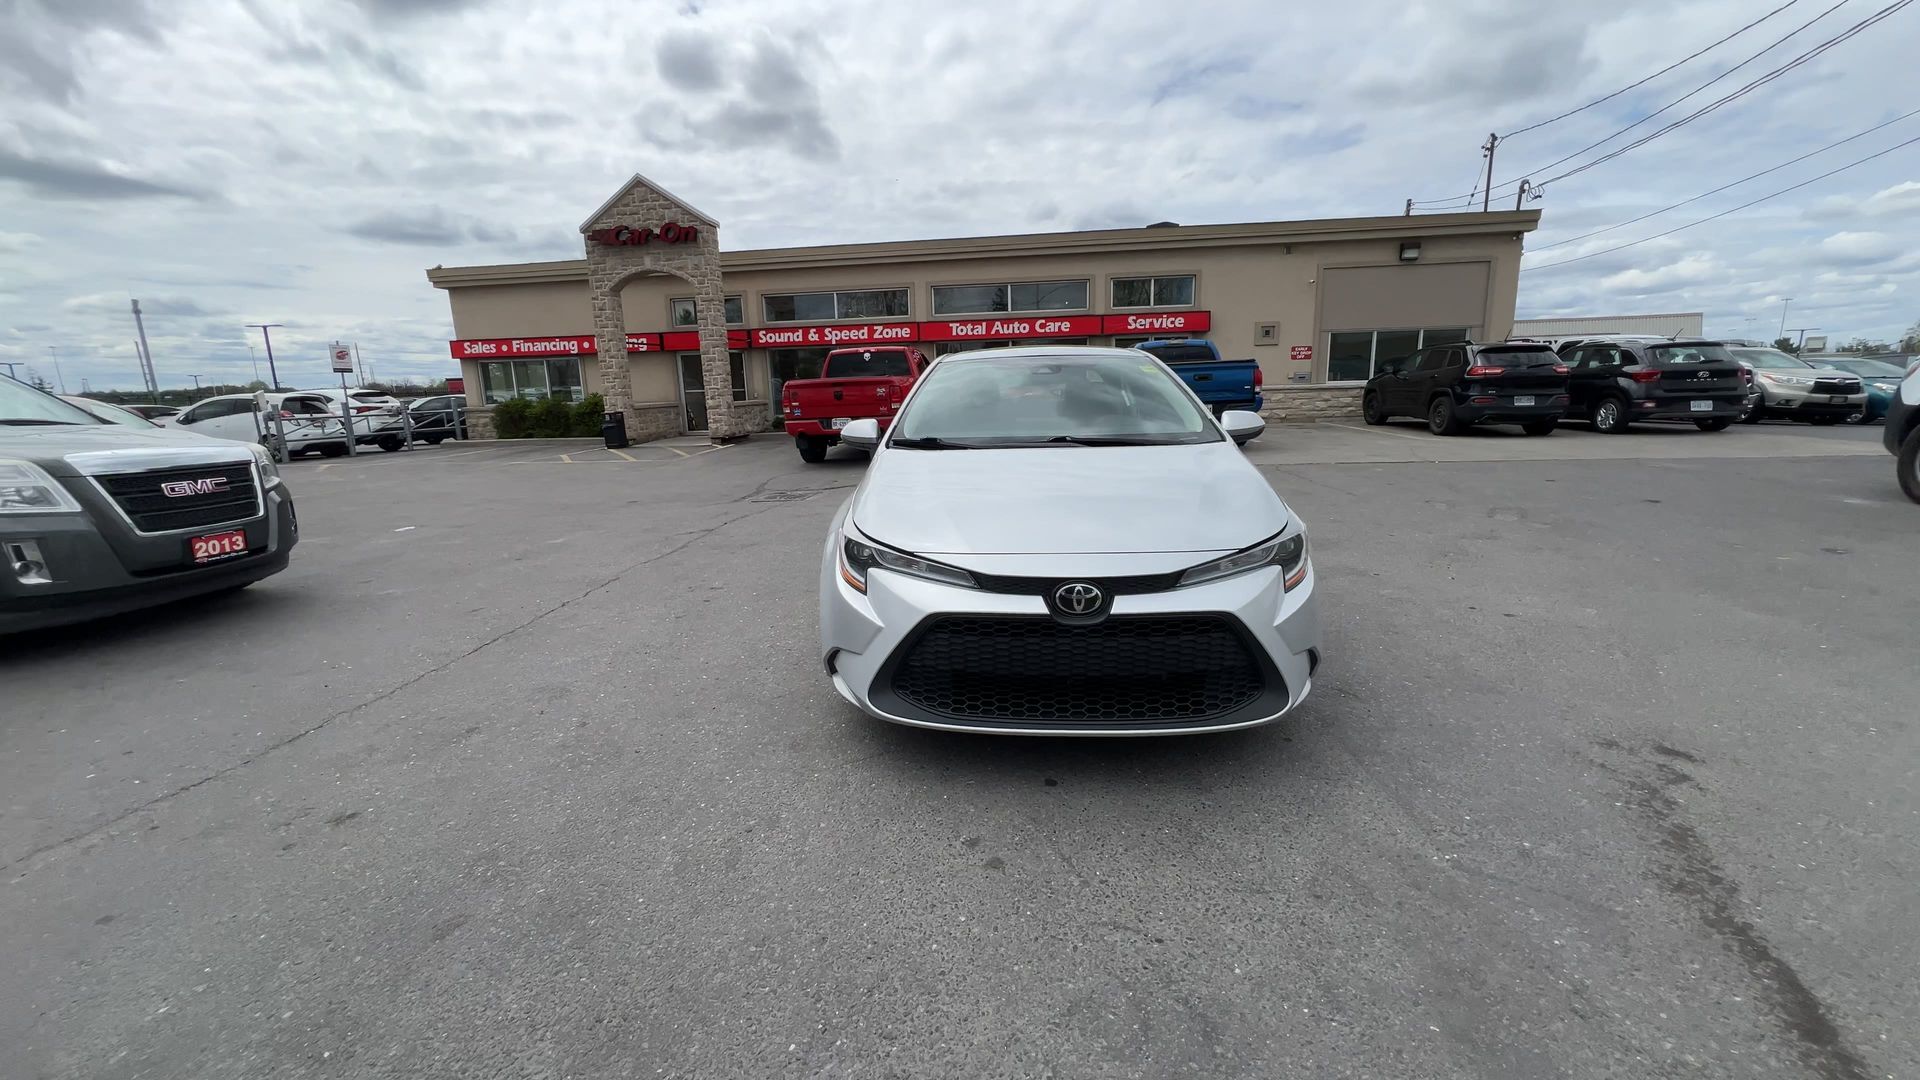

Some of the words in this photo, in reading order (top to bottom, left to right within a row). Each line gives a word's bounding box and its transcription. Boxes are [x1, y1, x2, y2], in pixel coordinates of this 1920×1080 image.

[611, 222, 698, 245] Car-On
[949, 322, 986, 336] Total
[990, 320, 1030, 335] Auto
[1034, 319, 1071, 333] Care
[1127, 314, 1185, 330] Service
[758, 329, 803, 344] Sound
[807, 328, 820, 342] &
[824, 326, 868, 344] Speed
[873, 325, 911, 339] Zone
[463, 340, 497, 355] Sales
[512, 338, 579, 355] Financing
[161, 477, 230, 497] GMC
[194, 536, 244, 558] 2013
